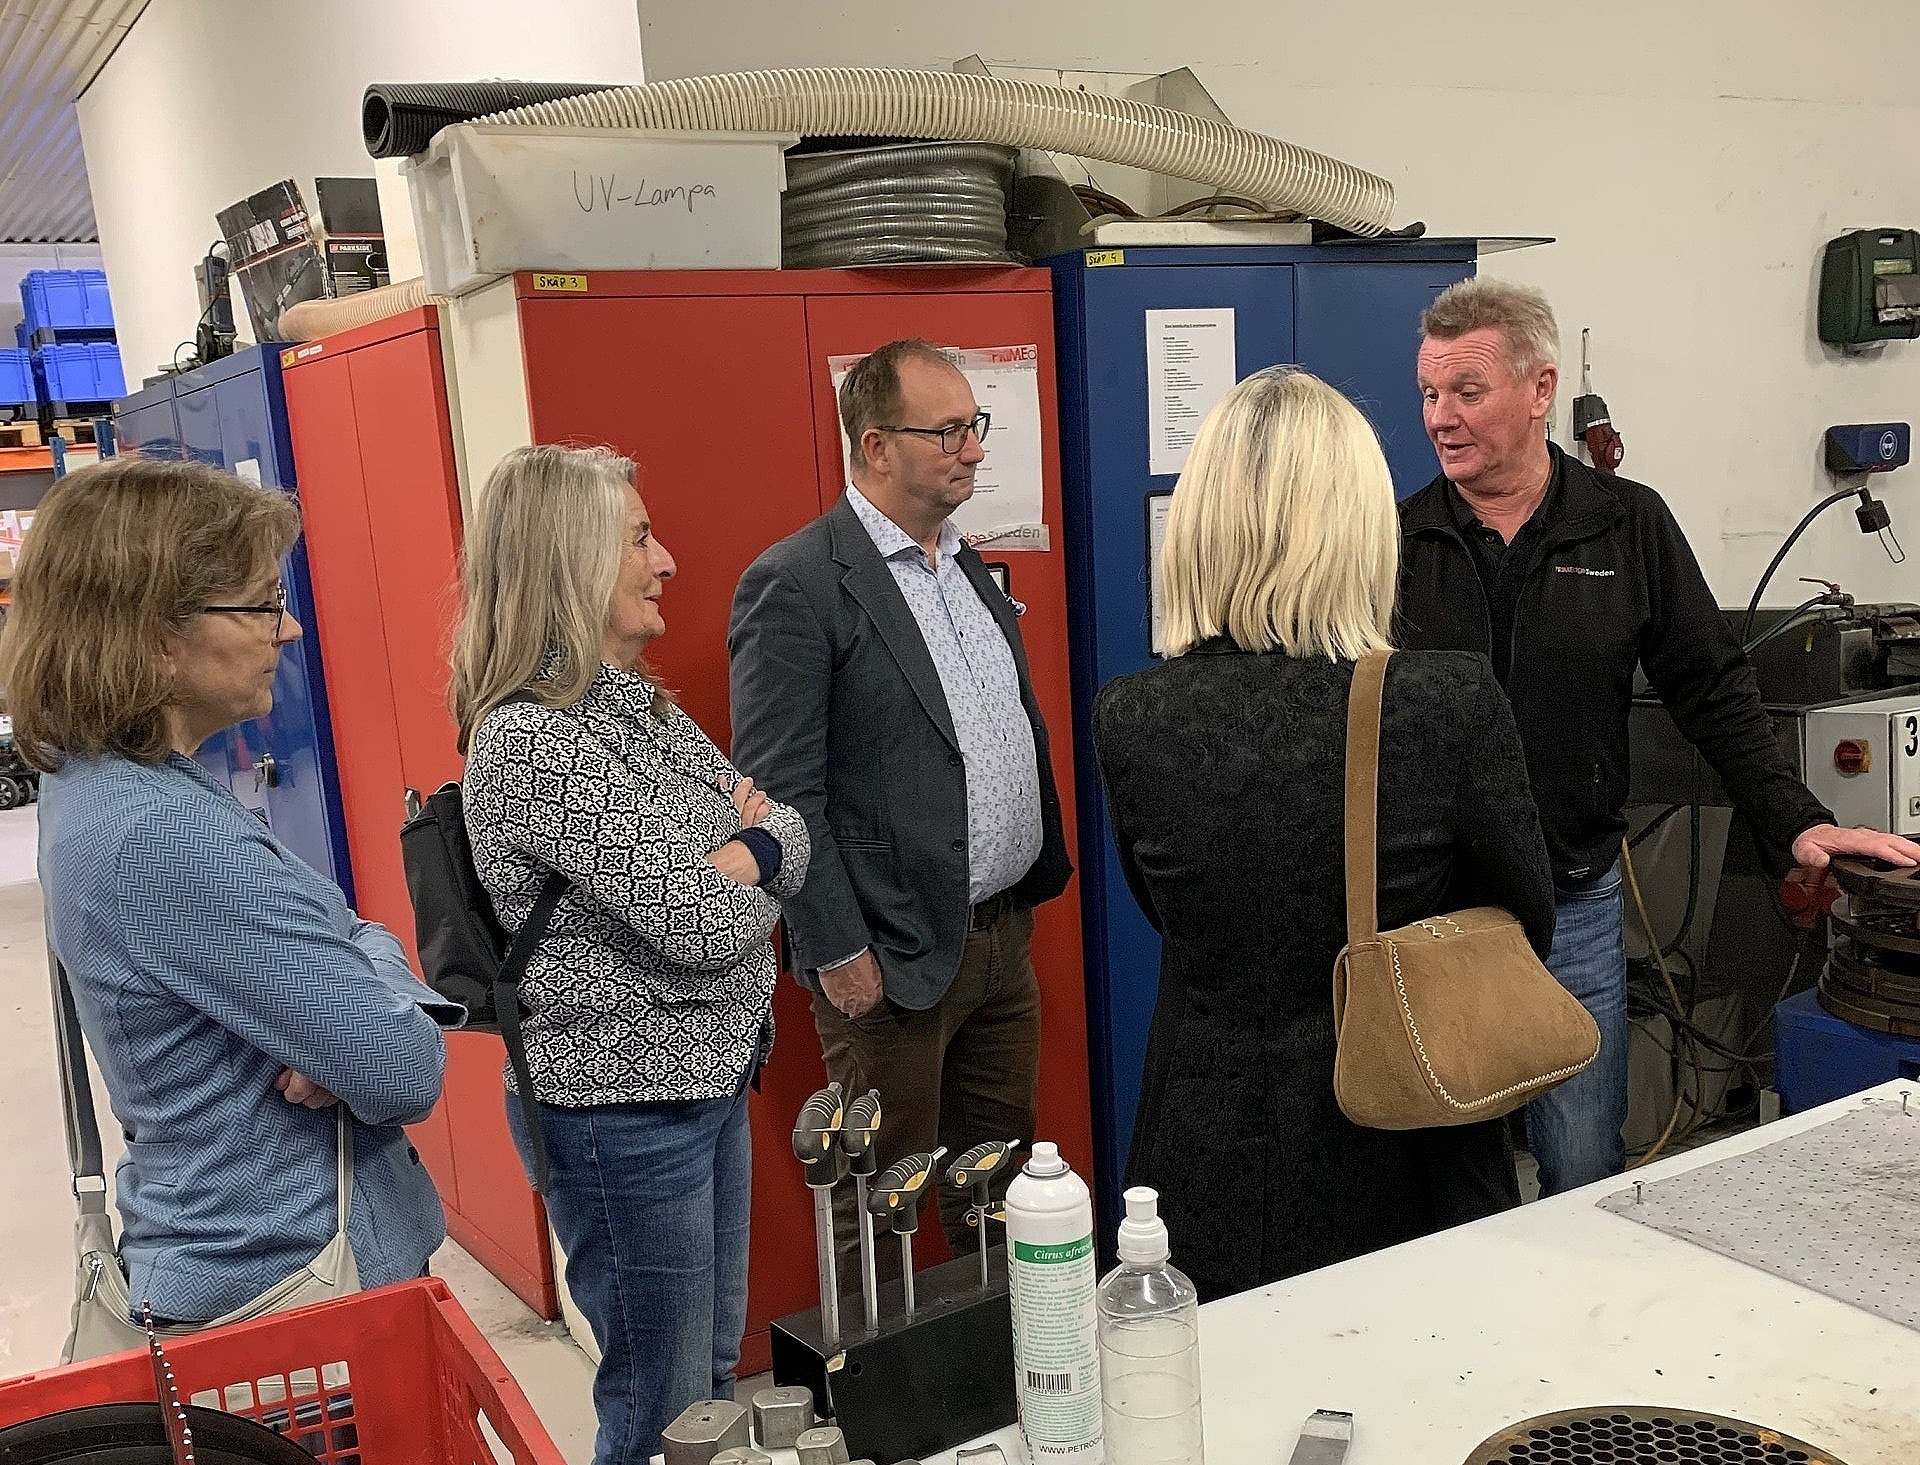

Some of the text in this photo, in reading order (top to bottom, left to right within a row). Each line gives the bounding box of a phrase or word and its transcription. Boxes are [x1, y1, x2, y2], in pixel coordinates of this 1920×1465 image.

[573, 170, 716, 213] UV-Lampa
[570, 277, 578, 288] 3
[1905, 716, 1919, 757] 3
[1034, 1249, 1063, 1260] Citrus
